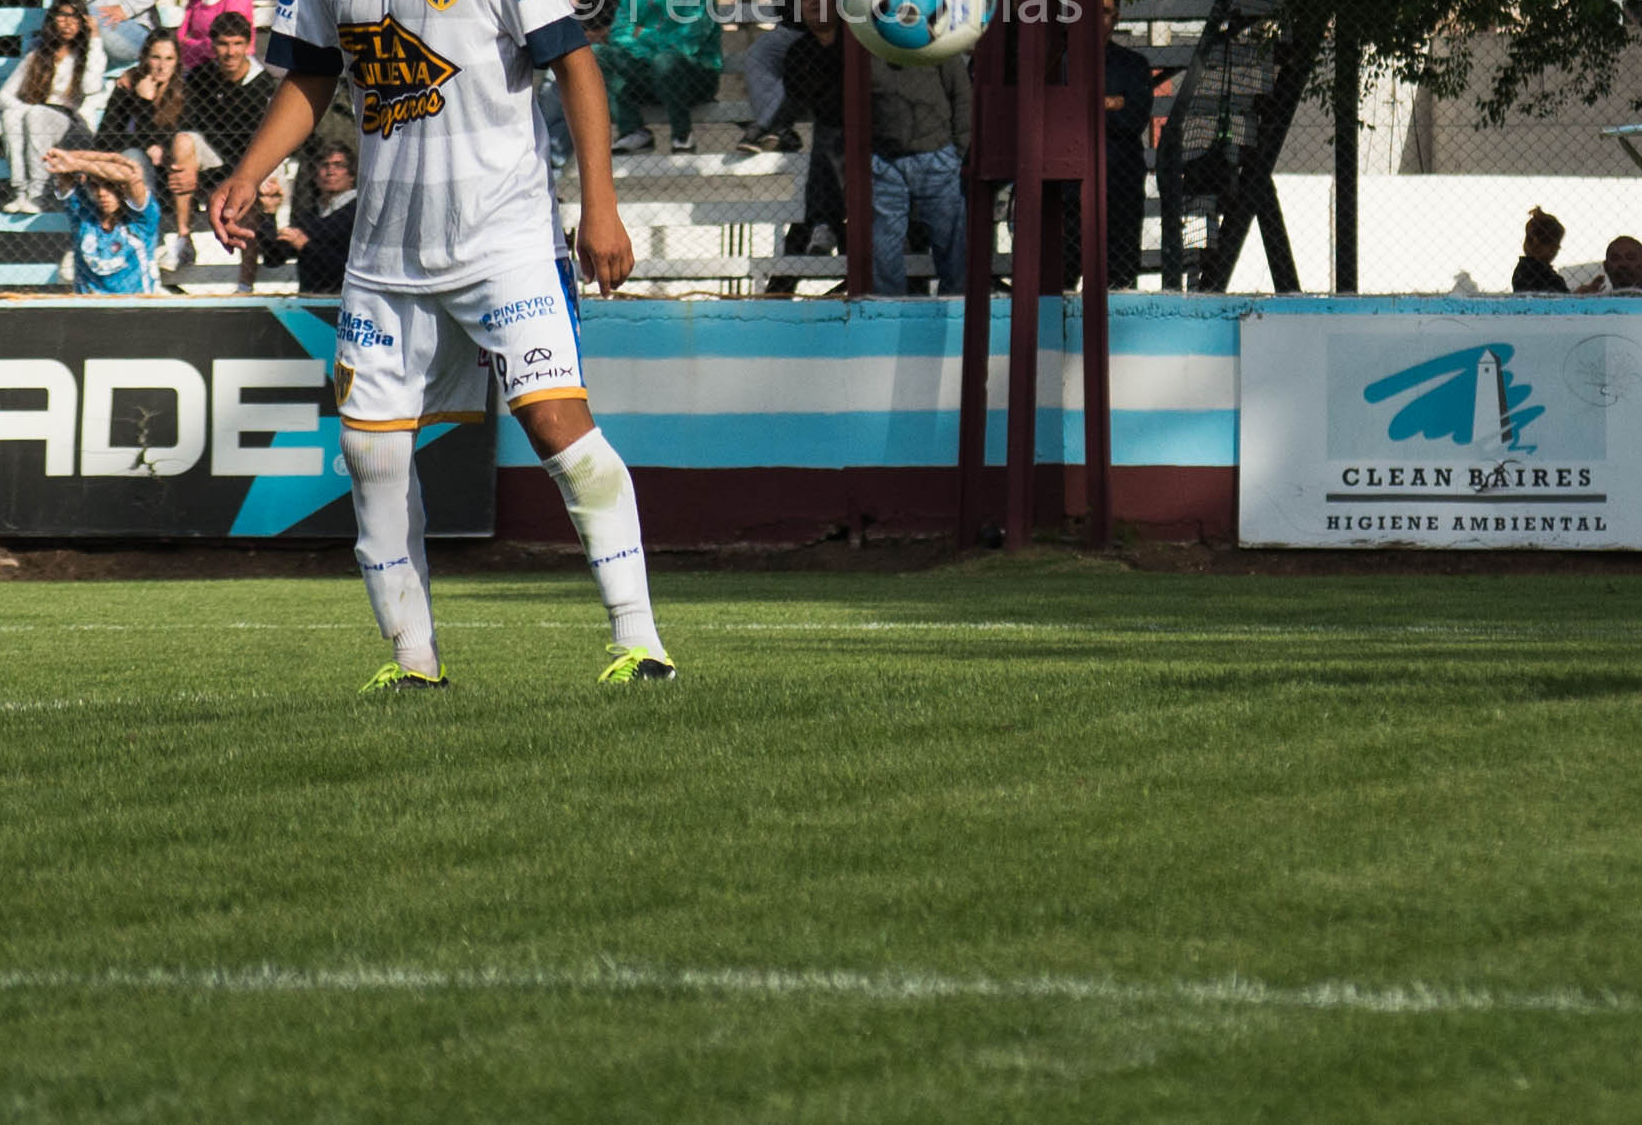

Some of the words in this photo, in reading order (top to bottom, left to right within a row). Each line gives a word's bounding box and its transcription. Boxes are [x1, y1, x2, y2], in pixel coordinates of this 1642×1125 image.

[373, 36, 405, 58] LA
[361, 62, 432, 85] NUEVA
[341, 310, 374, 331] Más
[496, 308, 557, 329] TRAVEL
[511, 367, 573, 391] ATHIX
[1342, 468, 1453, 487] CLEAN
[1469, 468, 1592, 487] BAIRES
[1326, 516, 1439, 531] HIGIENE
[1452, 516, 1607, 532] AMBIENTAL
[361, 557, 408, 571] HIX
[591, 547, 639, 568] THIX
